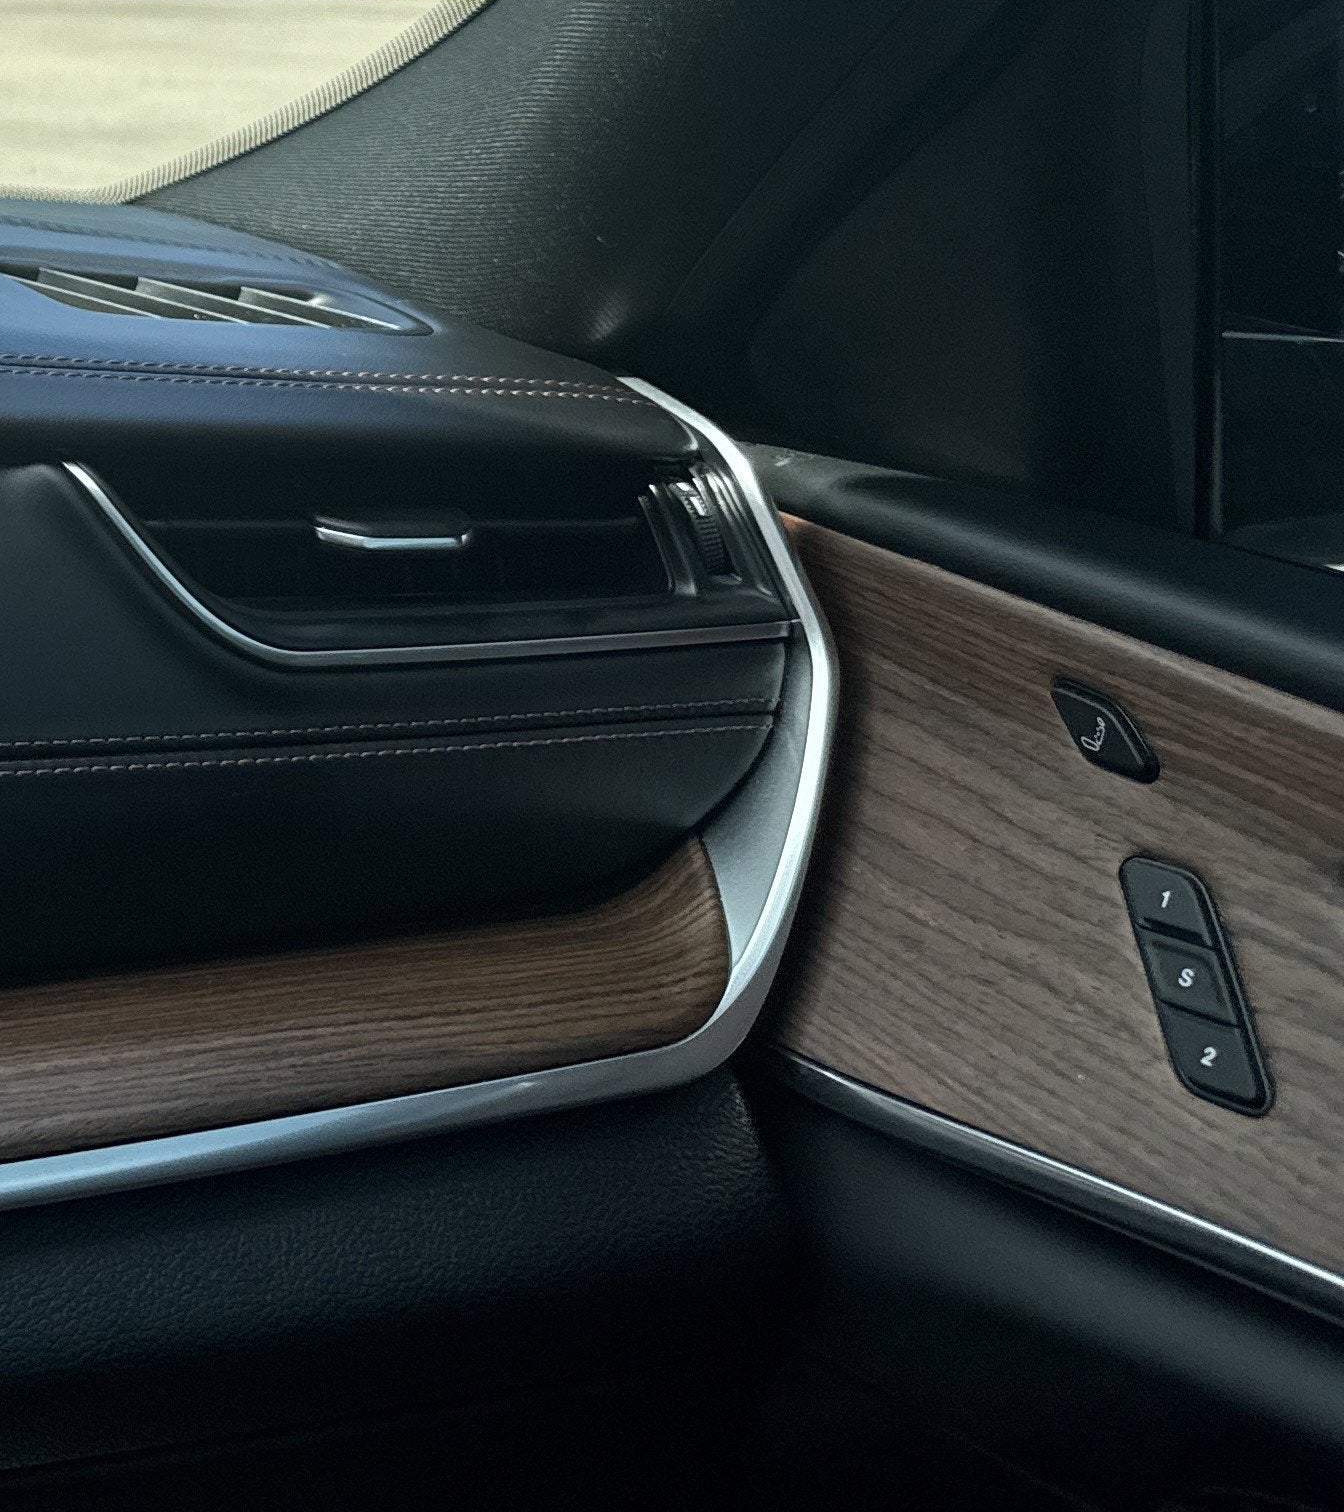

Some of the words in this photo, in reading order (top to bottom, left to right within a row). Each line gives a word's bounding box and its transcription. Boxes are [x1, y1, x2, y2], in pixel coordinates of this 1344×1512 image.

[1161, 890, 1171, 909] 1
[1178, 968, 1195, 988] S
[1200, 1046, 1218, 1067] 2
